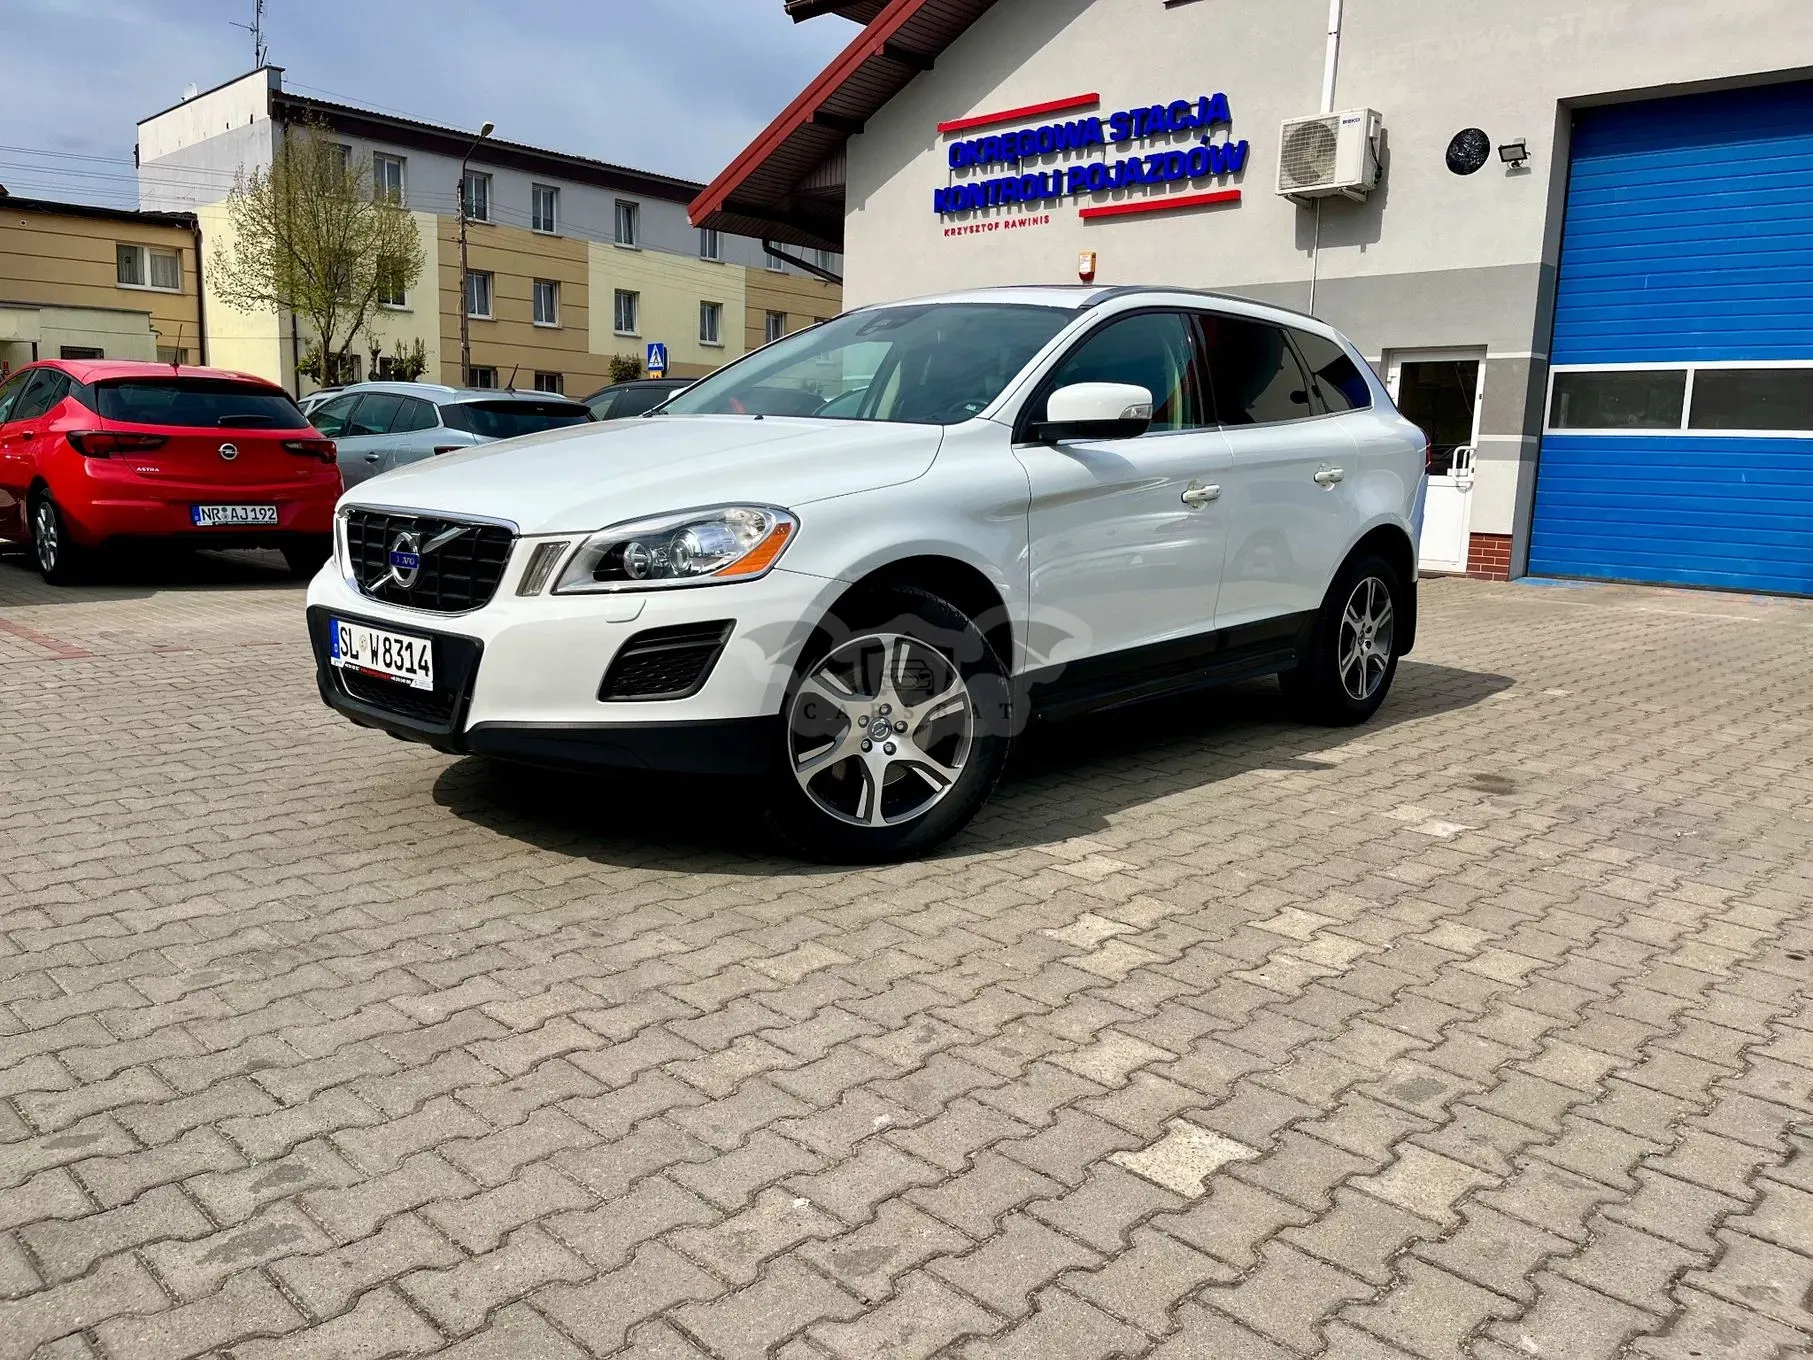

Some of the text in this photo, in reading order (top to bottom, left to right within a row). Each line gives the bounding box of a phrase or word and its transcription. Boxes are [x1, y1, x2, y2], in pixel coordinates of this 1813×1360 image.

[949, 93, 1231, 168] OKRĘGOWA STACJA
[934, 134, 1248, 213] KONTROLI POJAZDÓW
[944, 215, 1050, 237] KRZYSZTOF RAWINIS
[201, 507, 221, 521] NR
[340, 626, 359, 660] SL
